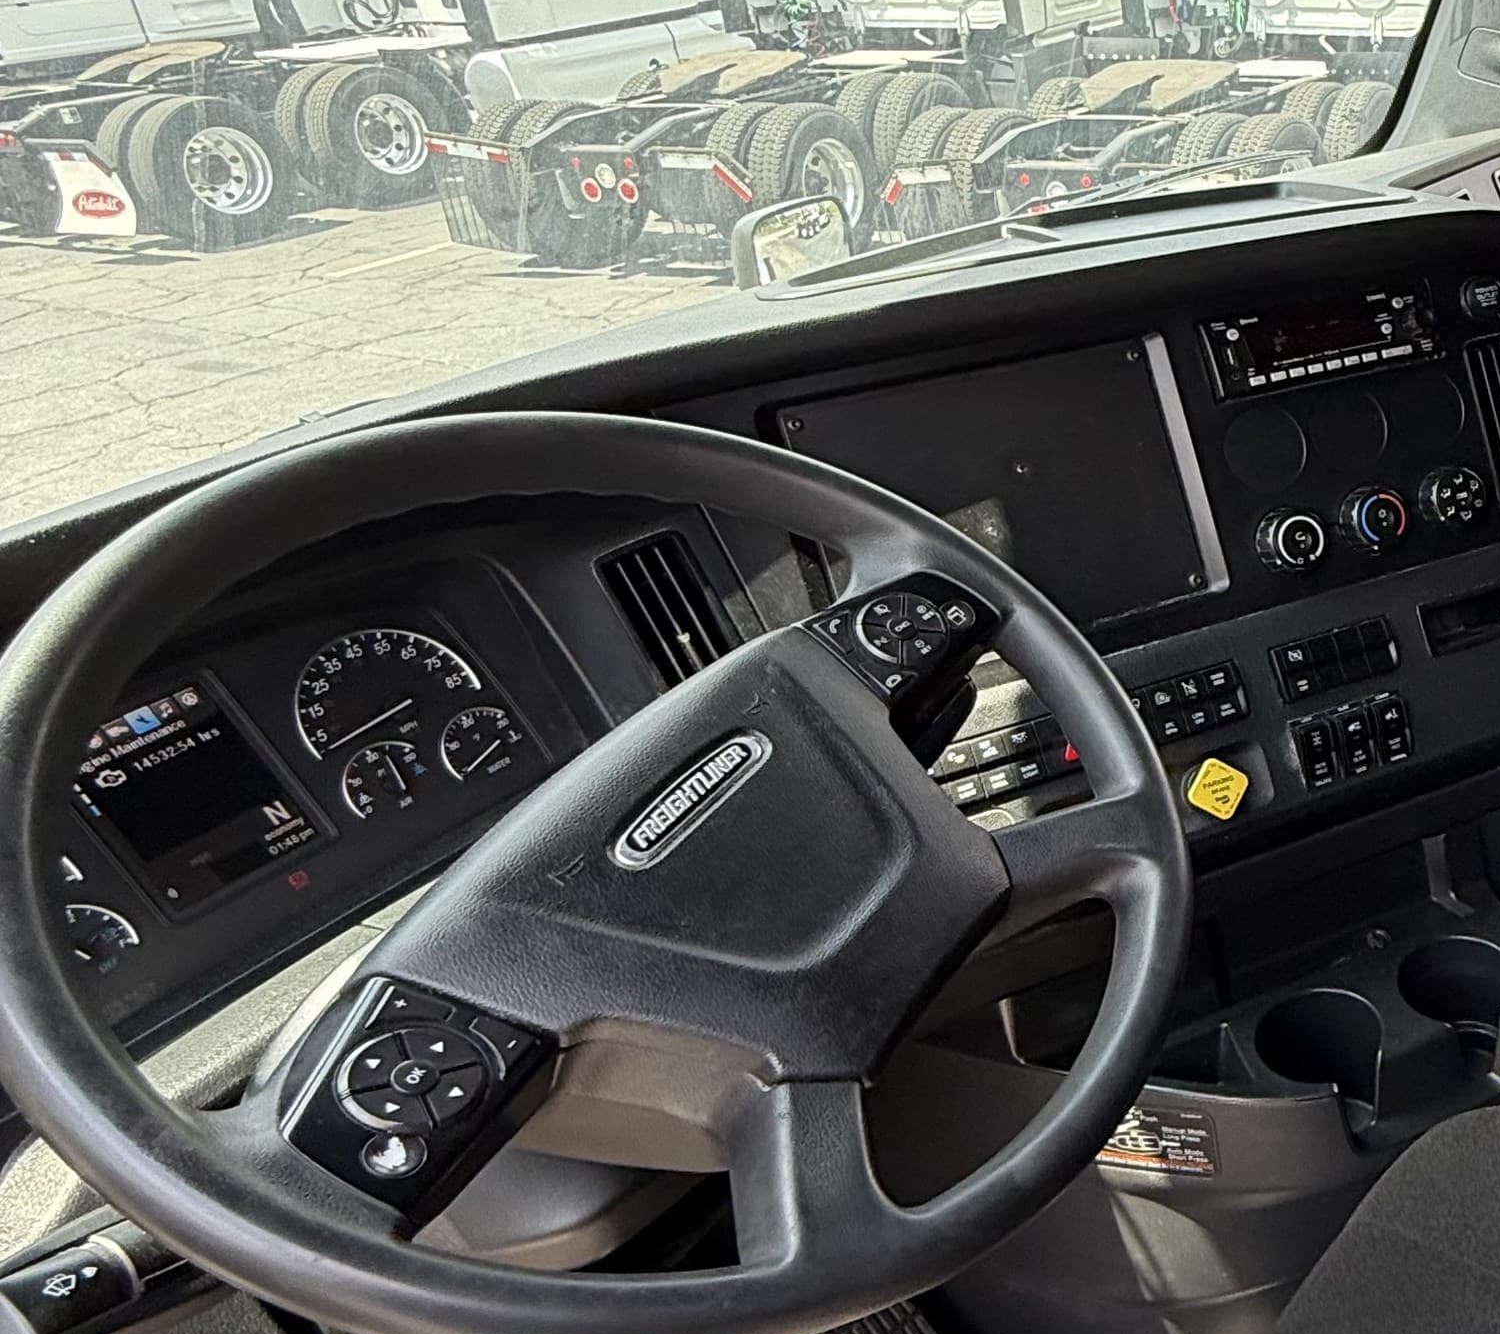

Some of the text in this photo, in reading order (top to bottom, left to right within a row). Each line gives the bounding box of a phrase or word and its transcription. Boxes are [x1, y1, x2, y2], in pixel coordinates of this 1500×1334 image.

[345, 643, 363, 660] 45
[373, 638, 391, 656] 55
[400, 644, 417, 661] 65
[323, 658, 342, 675] 35
[423, 656, 442, 672] 75
[311, 678, 330, 695] 25
[444, 673, 463, 690] 85
[308, 703, 325, 719] 15
[399, 720, 418, 734] MPH
[109, 719, 187, 759] Maintenance
[317, 729, 328, 743] 5
[133, 727, 222, 773] 14532:54 hrs
[1203, 774, 1234, 790] PARKING
[630, 744, 749, 850] FREIGHTLINER
[261, 800, 292, 826] N
[263, 816, 305, 842] economy
[299, 827, 316, 844] pm
[405, 1066, 427, 1084] OK
